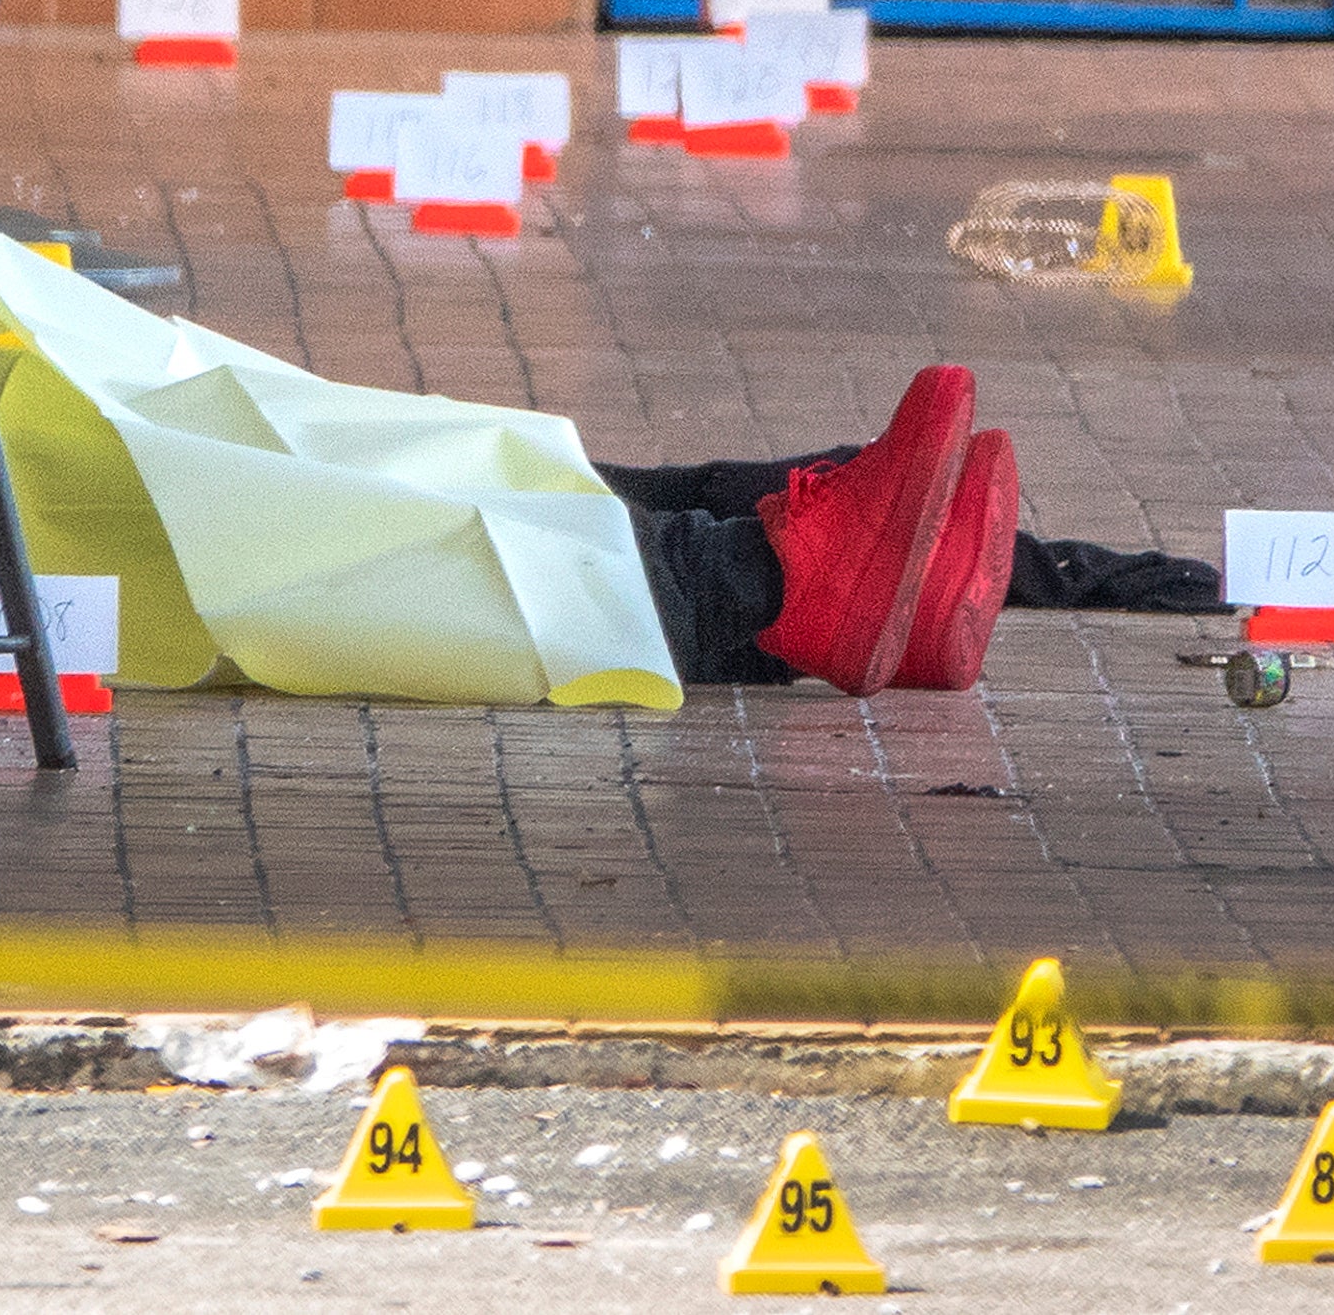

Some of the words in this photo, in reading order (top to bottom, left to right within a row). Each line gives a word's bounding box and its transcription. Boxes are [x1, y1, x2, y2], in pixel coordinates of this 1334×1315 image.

[1267, 534, 1332, 582] 112
[1009, 1009, 1063, 1067] 93
[369, 1122, 423, 1174] 94
[780, 1181, 834, 1233] 95
